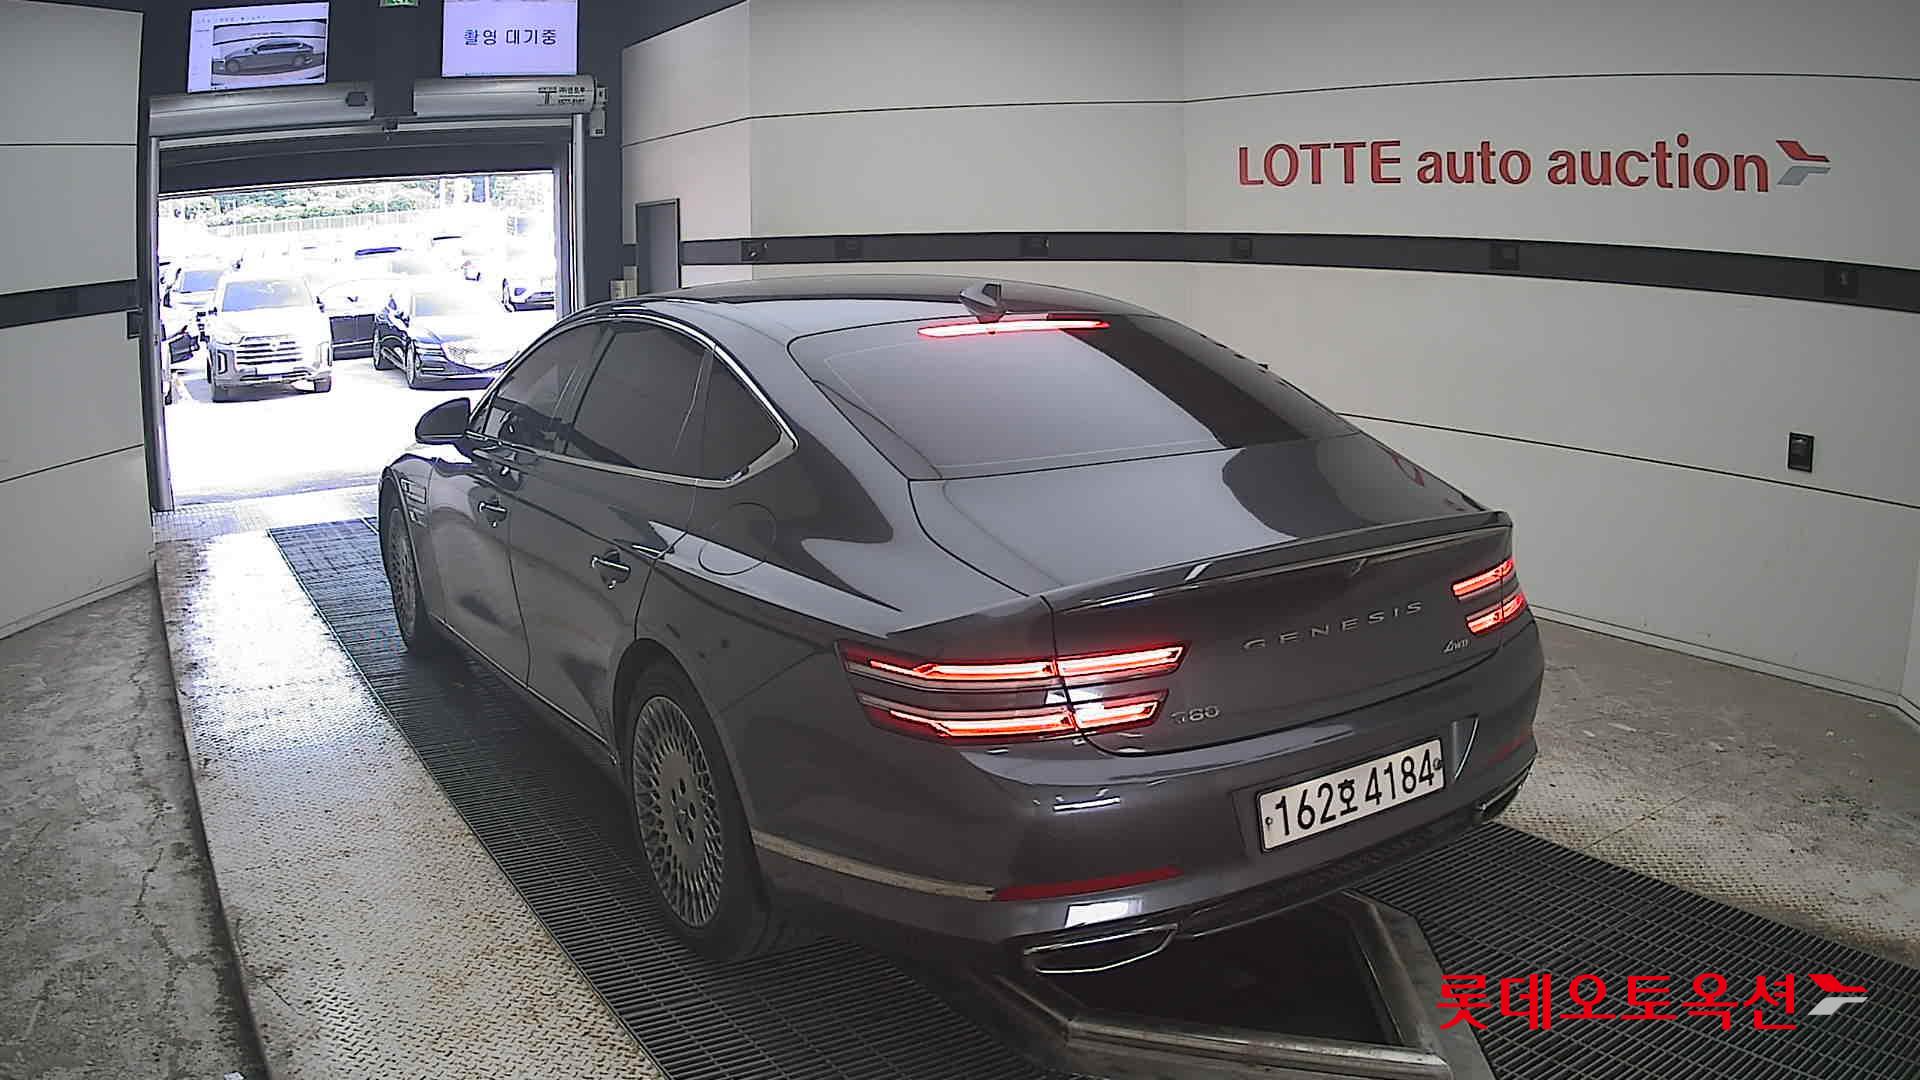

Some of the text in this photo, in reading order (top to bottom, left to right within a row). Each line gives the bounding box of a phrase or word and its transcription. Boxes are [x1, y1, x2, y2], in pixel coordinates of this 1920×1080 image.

[464, 29, 556, 45] 촬영 대기중
[1239, 133, 1769, 192] LOTTE auto auction
[1242, 601, 1422, 650] GENESIS
[1364, 748, 1435, 806] 4184
